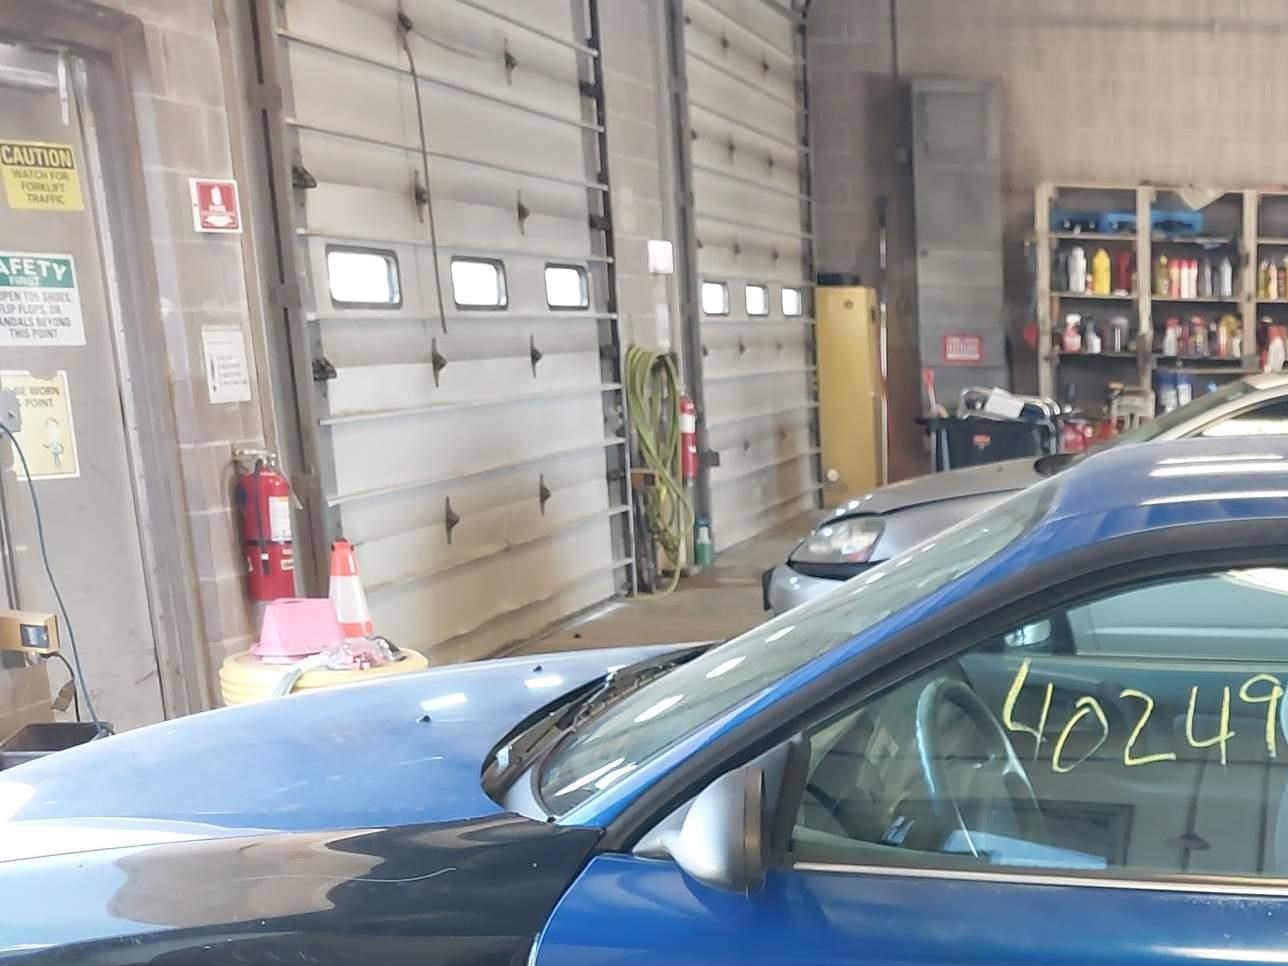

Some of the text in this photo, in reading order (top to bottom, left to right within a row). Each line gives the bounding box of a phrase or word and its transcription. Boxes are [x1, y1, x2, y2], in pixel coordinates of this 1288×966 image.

[1, 145, 73, 168] CAUTION
[11, 168, 70, 181] WATCH FOR
[21, 181, 65, 193] FORKLIFT
[26, 193, 66, 204] TRAFFIC
[9, 328, 58, 339] THIS POINT
[29, 386, 60, 396] WORN
[25, 398, 53, 408] POINT
